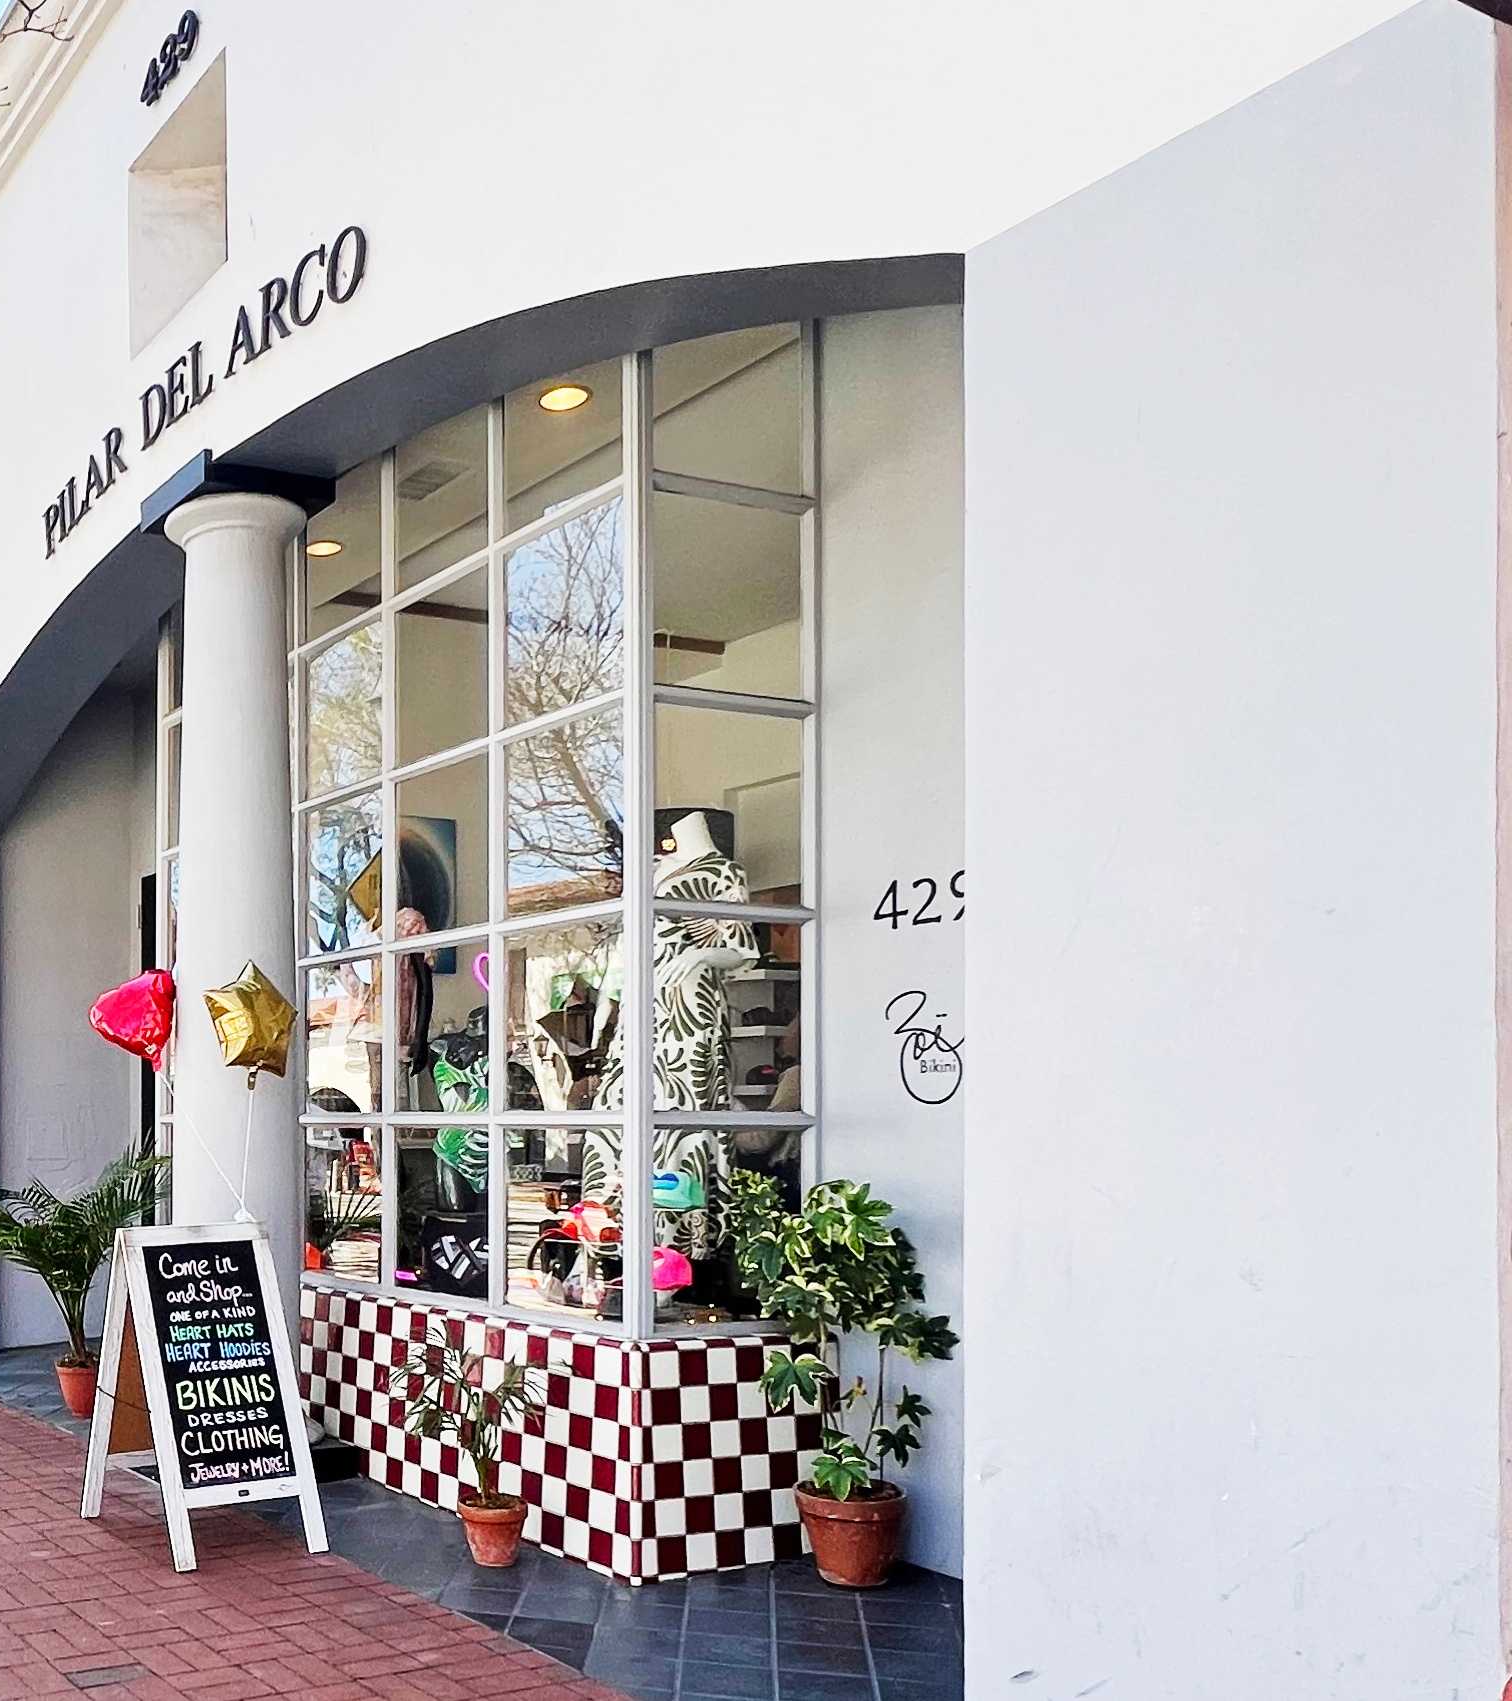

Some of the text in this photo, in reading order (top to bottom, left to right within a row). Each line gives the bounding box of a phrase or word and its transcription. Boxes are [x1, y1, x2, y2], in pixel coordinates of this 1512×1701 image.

[140, 9, 199, 106] 429
[42, 226, 367, 559] PILAR DEL ARCO
[920, 1060, 957, 1074] Bikini
[159, 1253, 239, 1279] Come in
[167, 1283, 200, 1304] and
[170, 1306, 256, 1322] ONE OF A KIND
[169, 1323, 254, 1342] HEART HATS
[165, 1343, 211, 1362] HEART
[176, 1374, 275, 1410] BIKINIS
[188, 1407, 268, 1427] DRESSES
[181, 1425, 284, 1456] CLOTHING
[249, 1451, 289, 1476] MORE!
